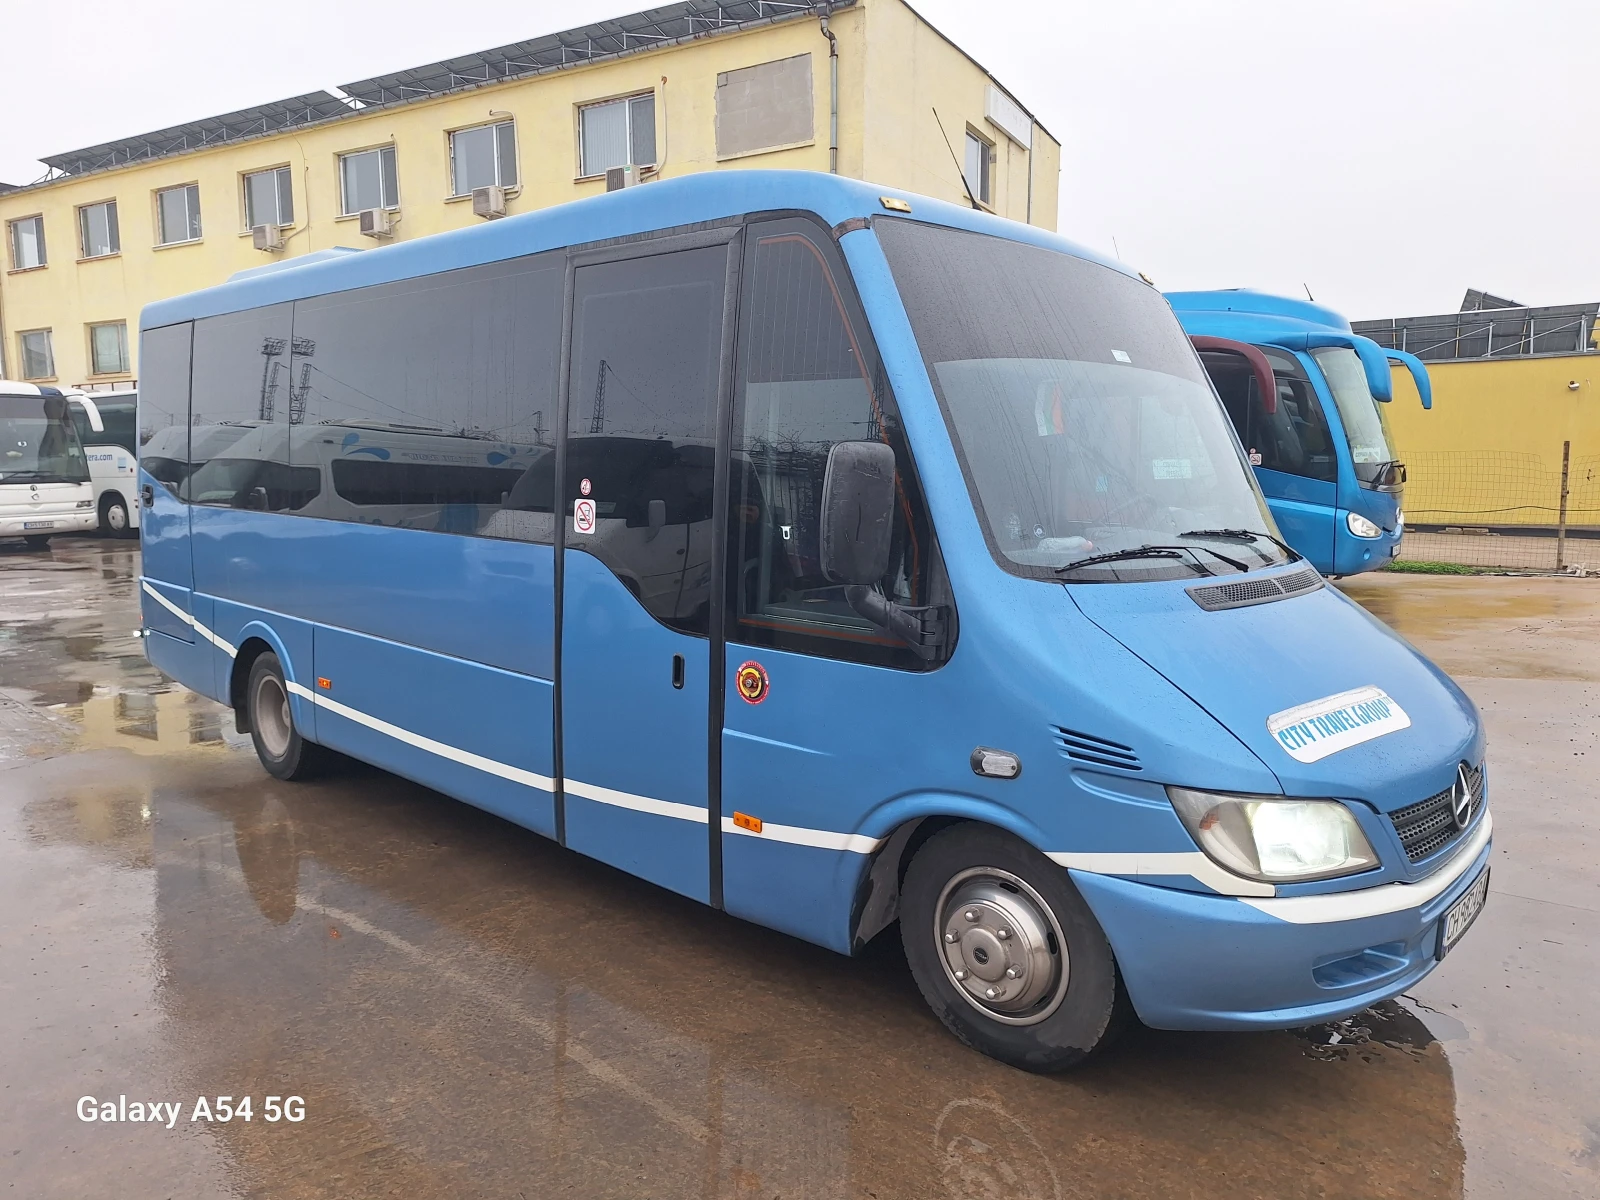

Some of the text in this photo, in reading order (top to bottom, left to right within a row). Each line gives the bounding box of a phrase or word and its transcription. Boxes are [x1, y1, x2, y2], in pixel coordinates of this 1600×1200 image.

[1277, 722, 1316, 750] CITY
[1307, 708, 1360, 738] TRAVEL
[1351, 698, 1392, 724] GROUP
